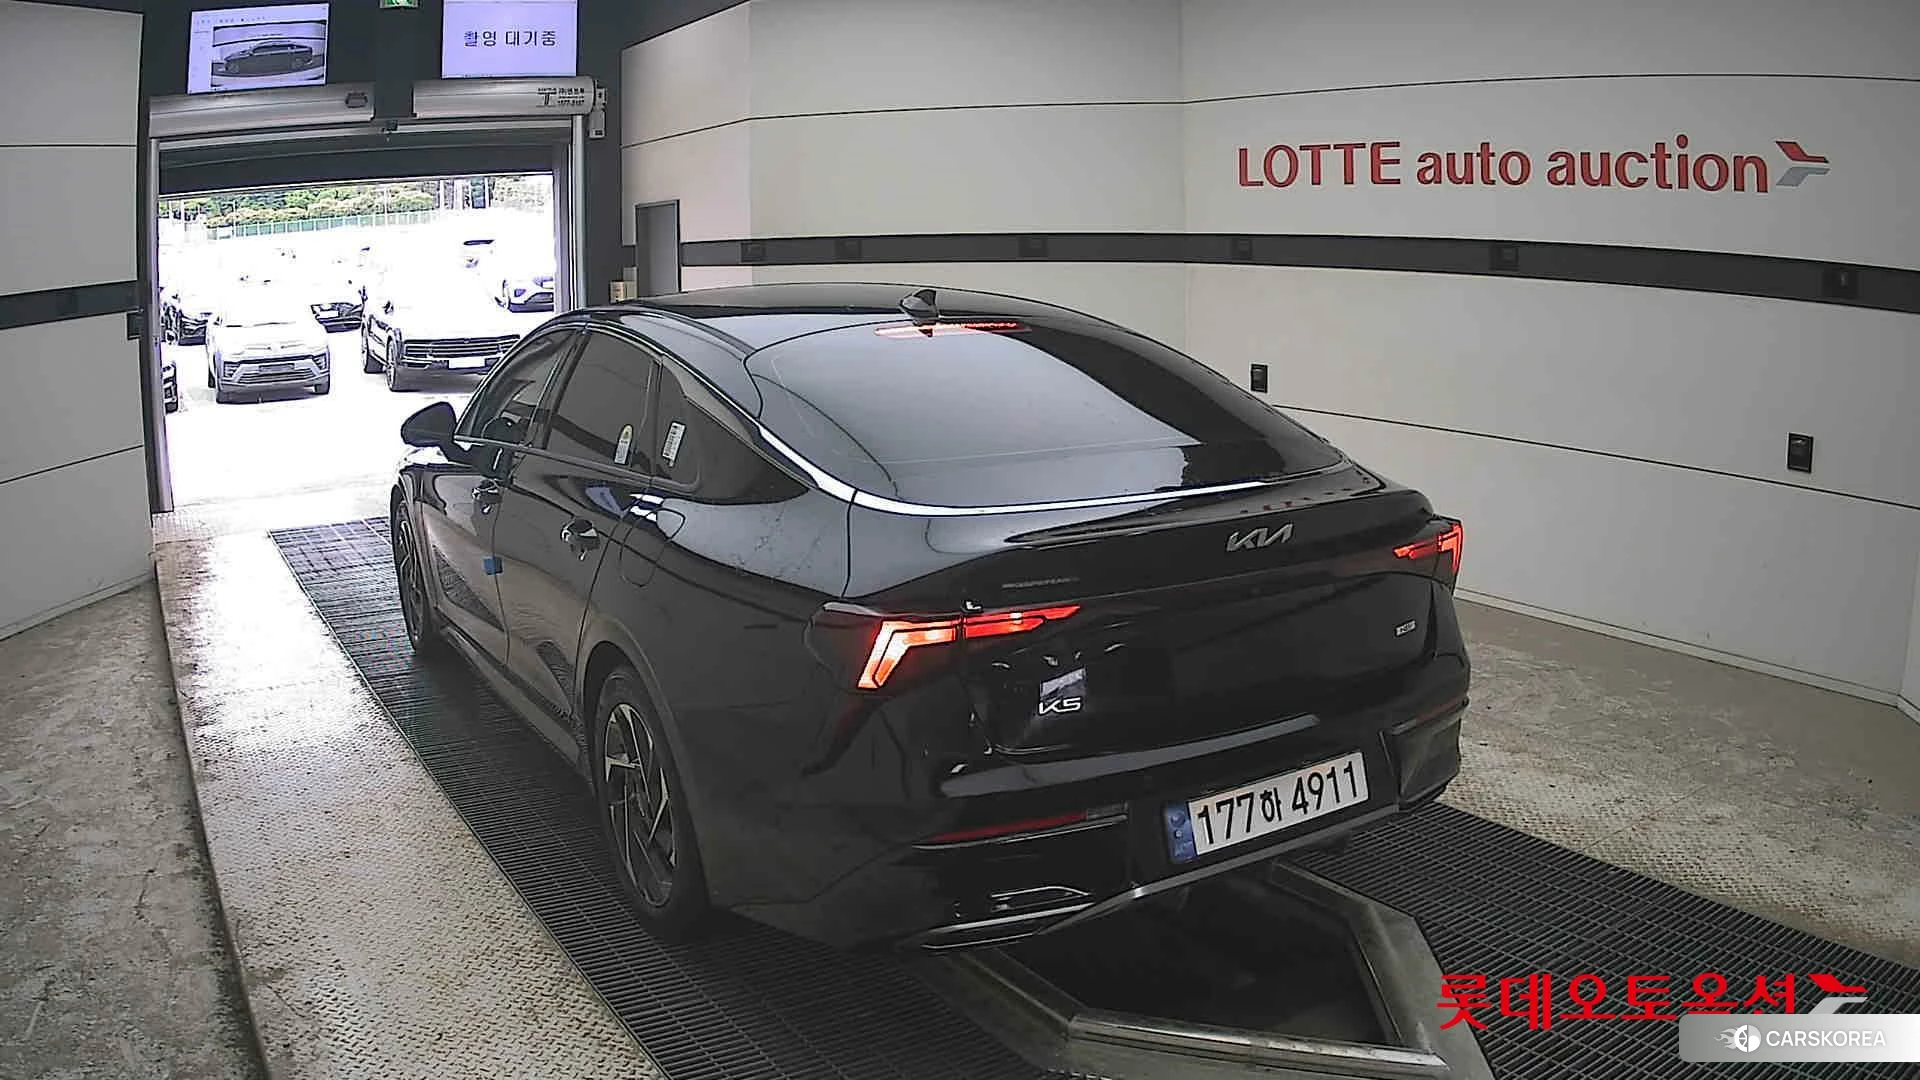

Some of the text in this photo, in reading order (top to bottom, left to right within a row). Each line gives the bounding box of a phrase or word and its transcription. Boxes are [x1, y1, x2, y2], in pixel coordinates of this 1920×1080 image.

[463, 30, 557, 48] 촬영 대기중
[1239, 134, 1769, 193] LOTTE auto auction
[1226, 523, 1294, 552] KIA
[1038, 697, 1082, 716] K5
[1197, 760, 1358, 845] 177하 4911
